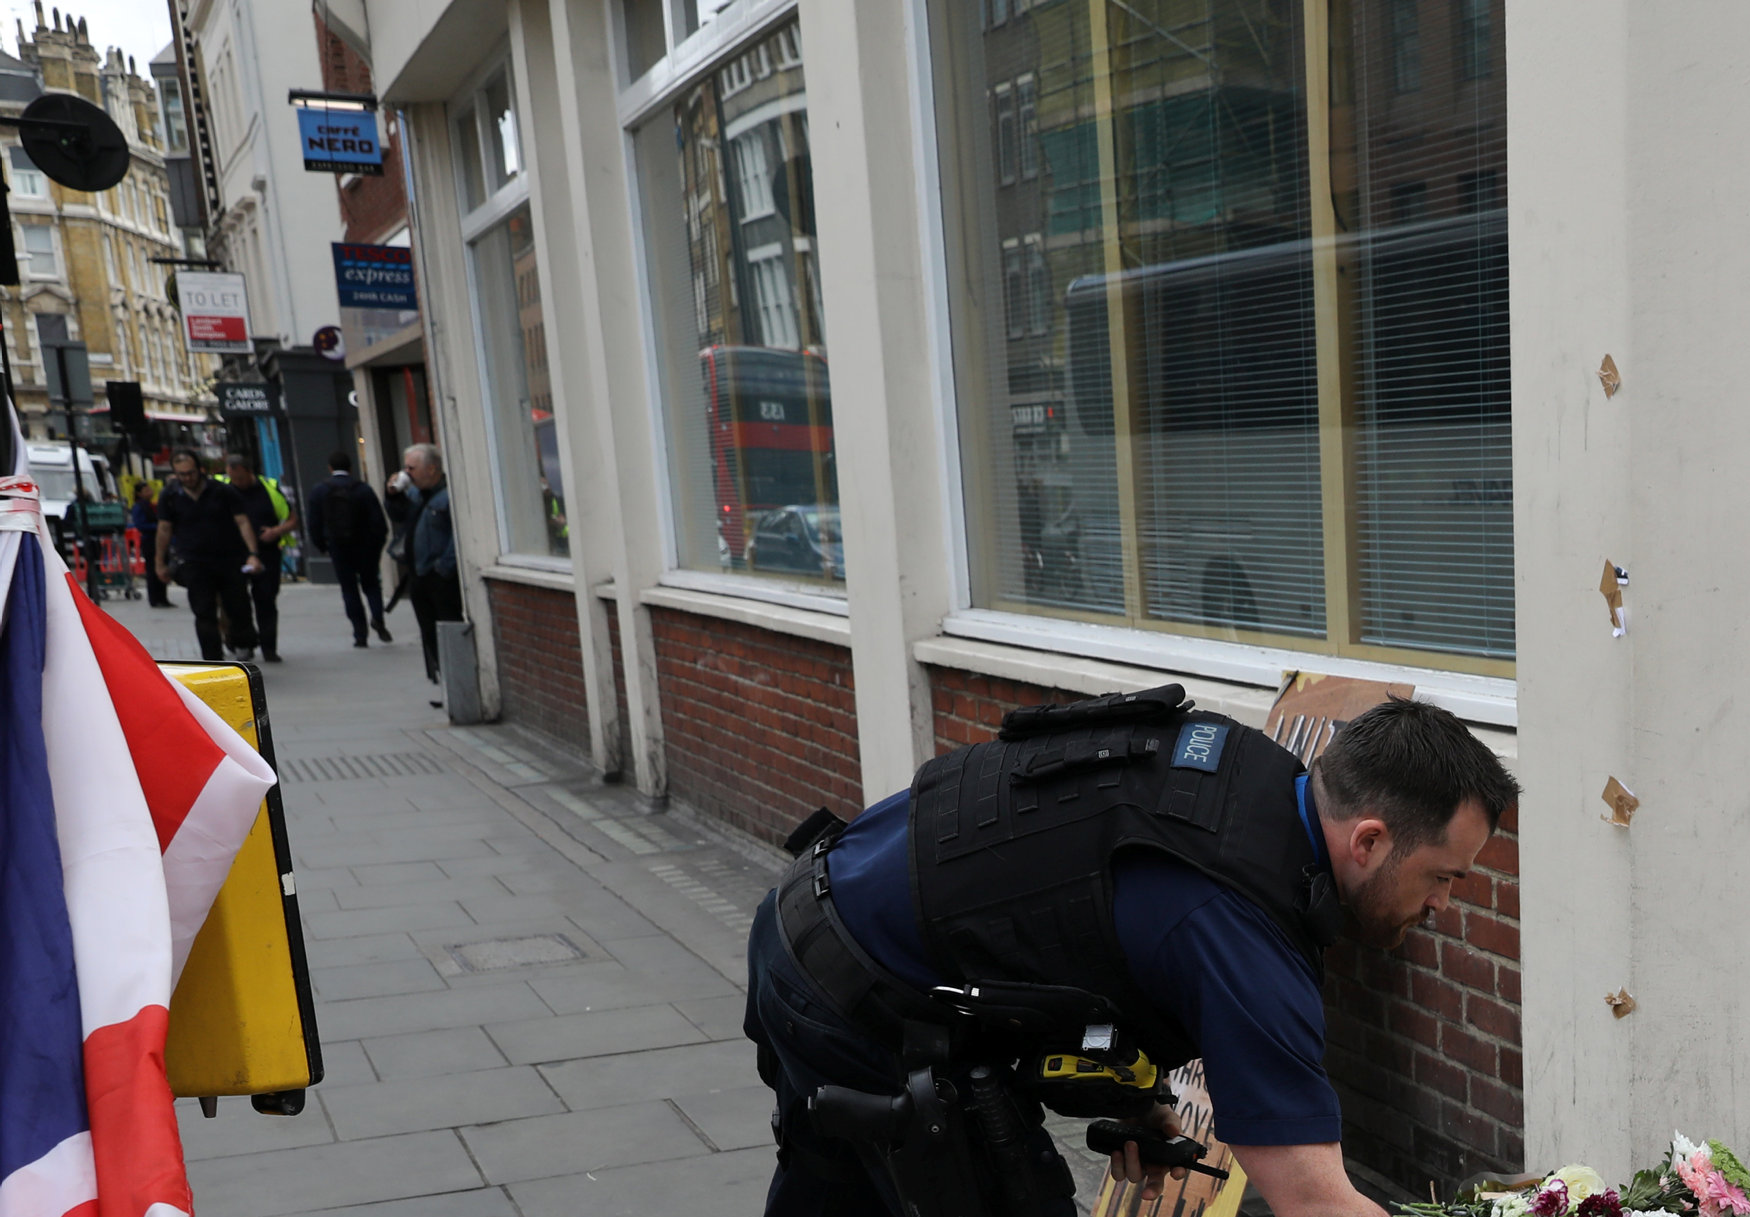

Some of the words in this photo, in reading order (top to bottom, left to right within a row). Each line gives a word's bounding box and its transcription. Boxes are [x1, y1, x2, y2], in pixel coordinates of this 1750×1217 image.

[308, 136, 374, 154] NERO
[338, 245, 411, 263] TESCO
[344, 267, 411, 285] express
[186, 292, 206, 306] TO
[211, 293, 239, 308] LET
[380, 292, 407, 303] CASH
[226, 388, 266, 399] CARDS
[225, 400, 270, 411] GALORE
[1184, 724, 1217, 763] POLICE
